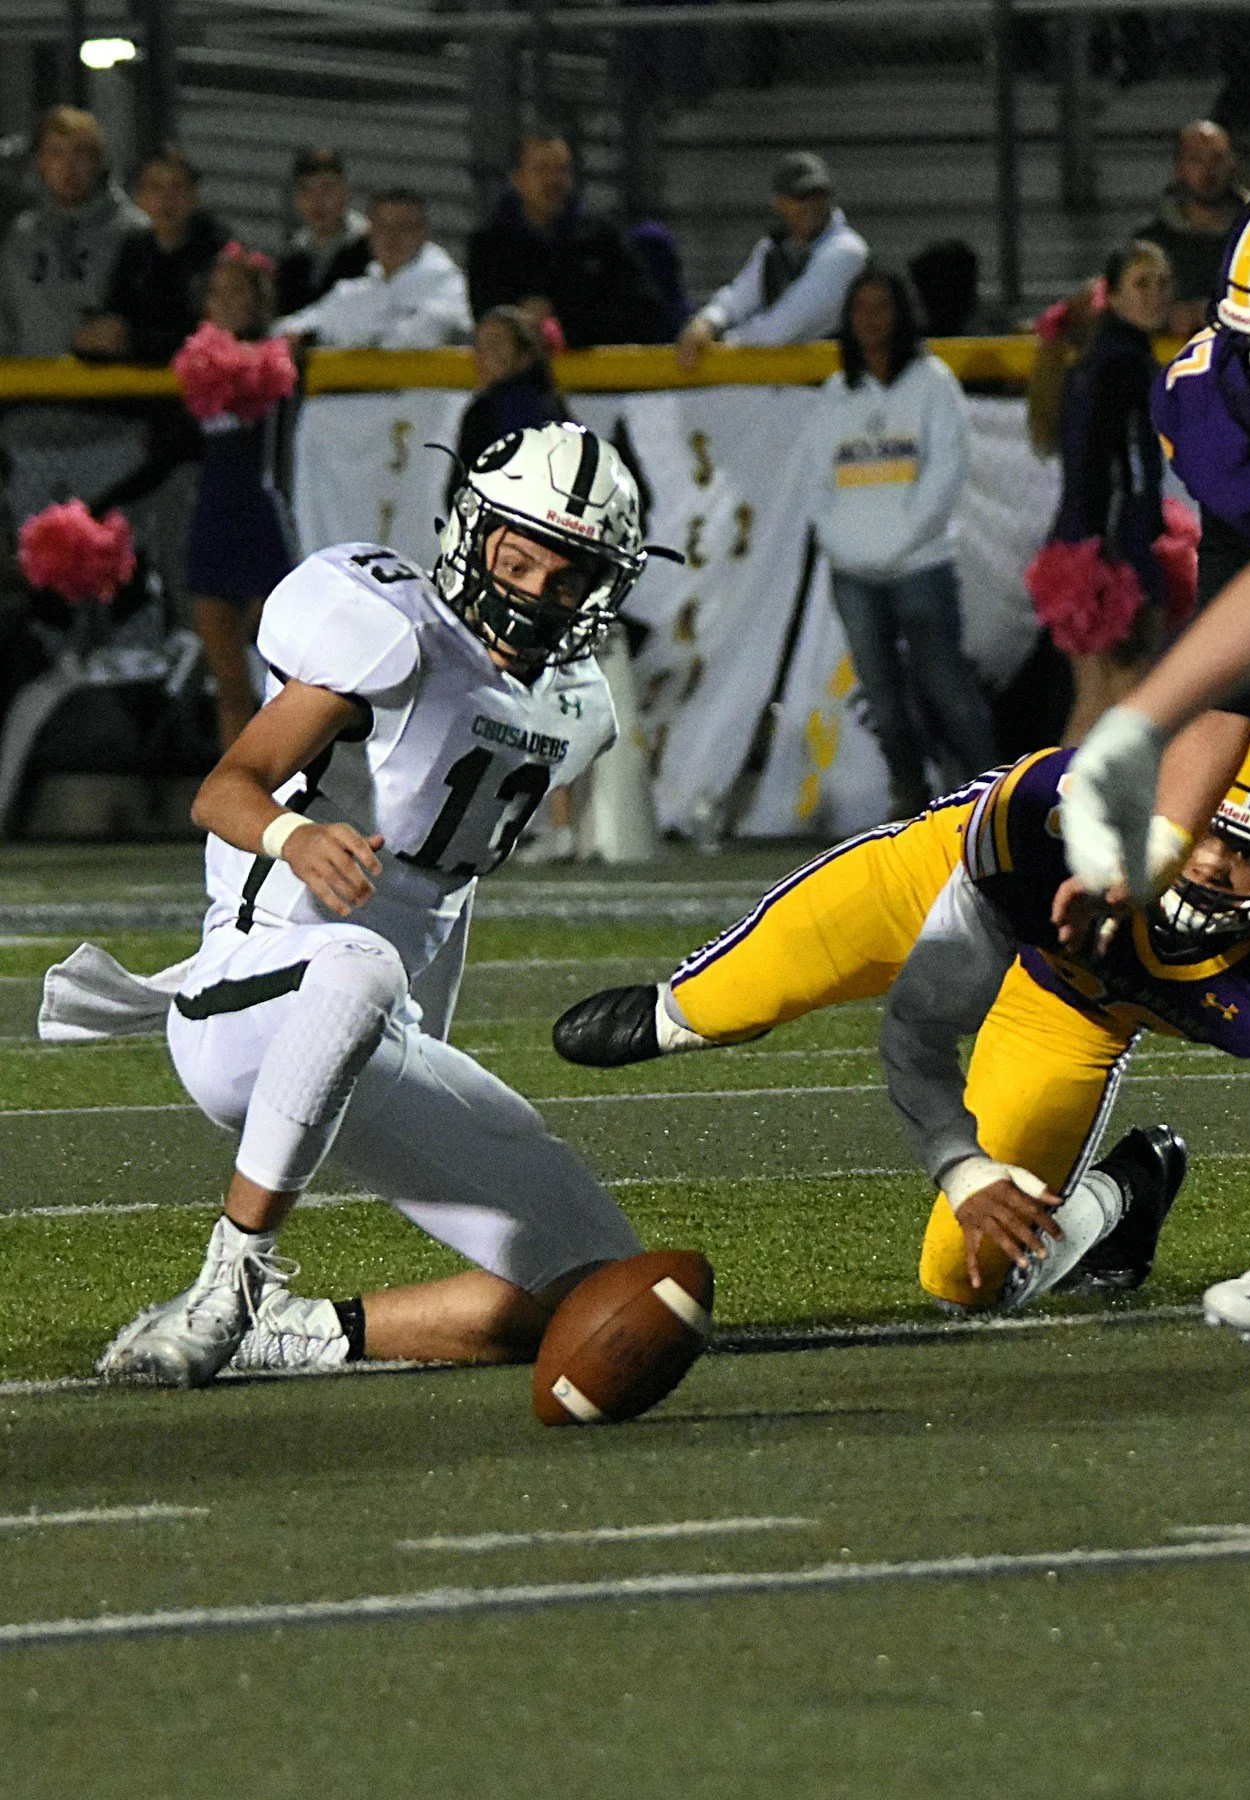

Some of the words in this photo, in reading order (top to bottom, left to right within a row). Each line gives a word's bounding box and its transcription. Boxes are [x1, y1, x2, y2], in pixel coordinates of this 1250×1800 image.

[545, 509, 596, 538] Riddell
[350, 549, 422, 584] 13
[471, 714, 570, 760] CRUSADERS
[394, 745, 551, 878] 13
